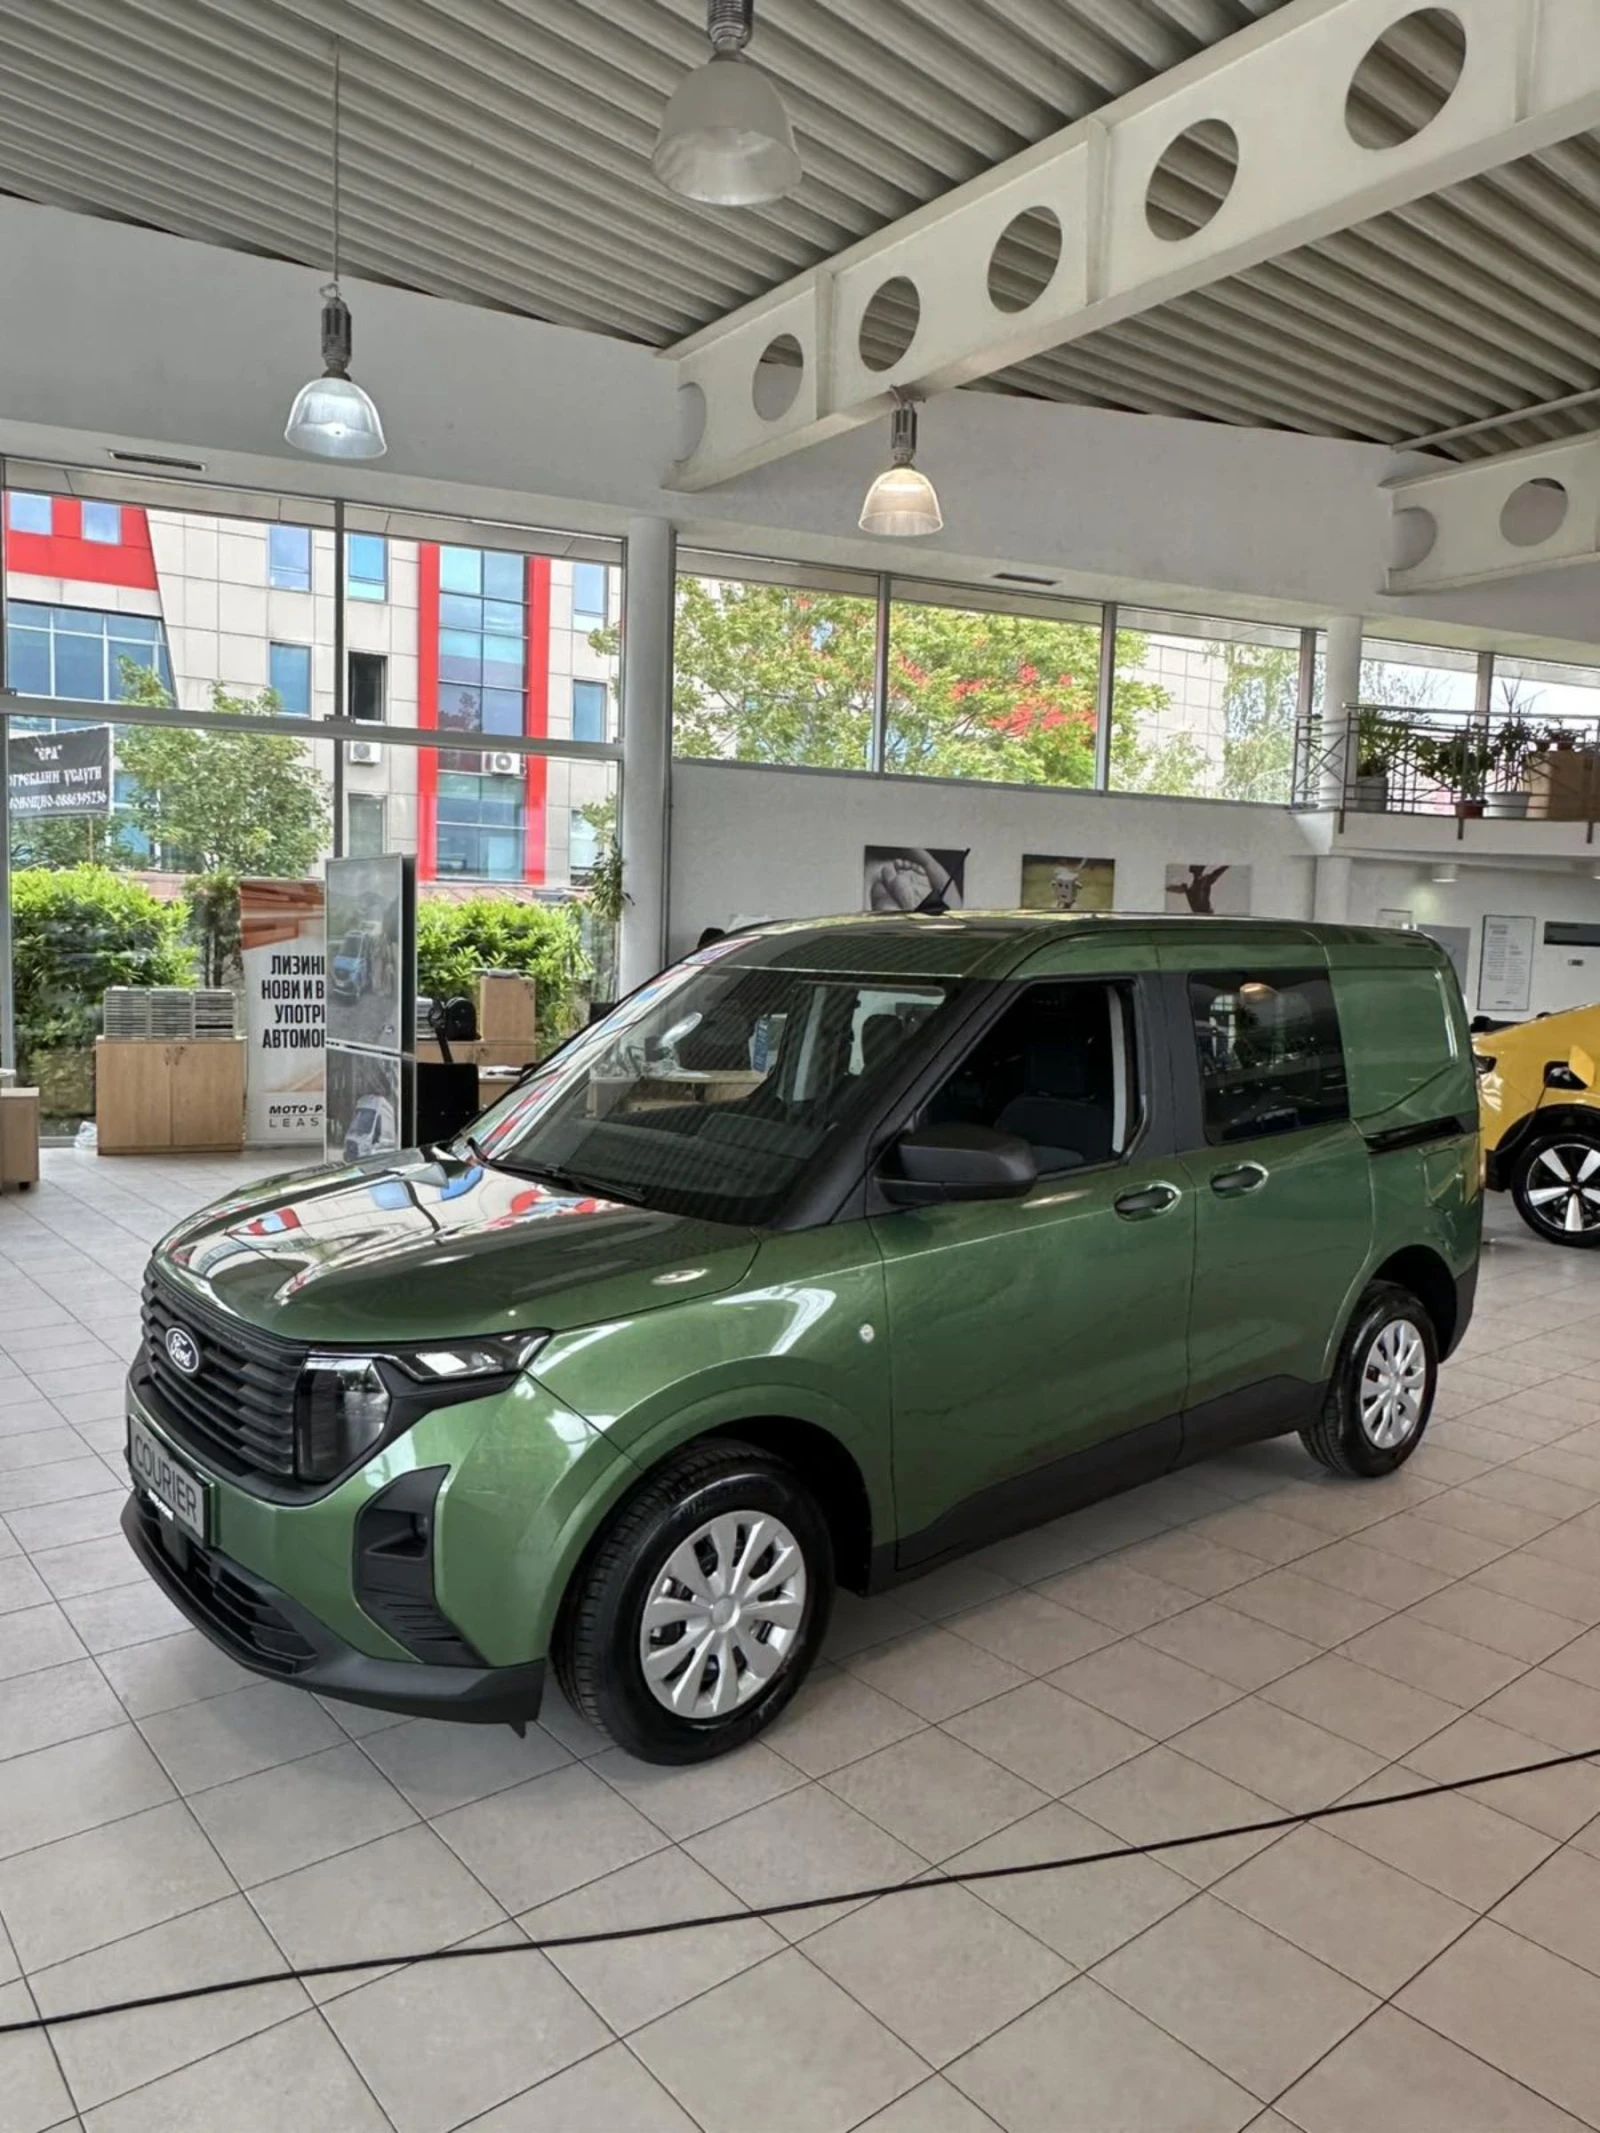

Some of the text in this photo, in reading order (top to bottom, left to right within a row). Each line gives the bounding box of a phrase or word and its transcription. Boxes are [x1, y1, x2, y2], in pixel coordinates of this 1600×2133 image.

[262, 980, 324, 999] НОВИ И В
[269, 1117, 320, 1128] LEAS
[169, 1332, 193, 1368] Ford
[134, 1434, 197, 1523] COURIER
